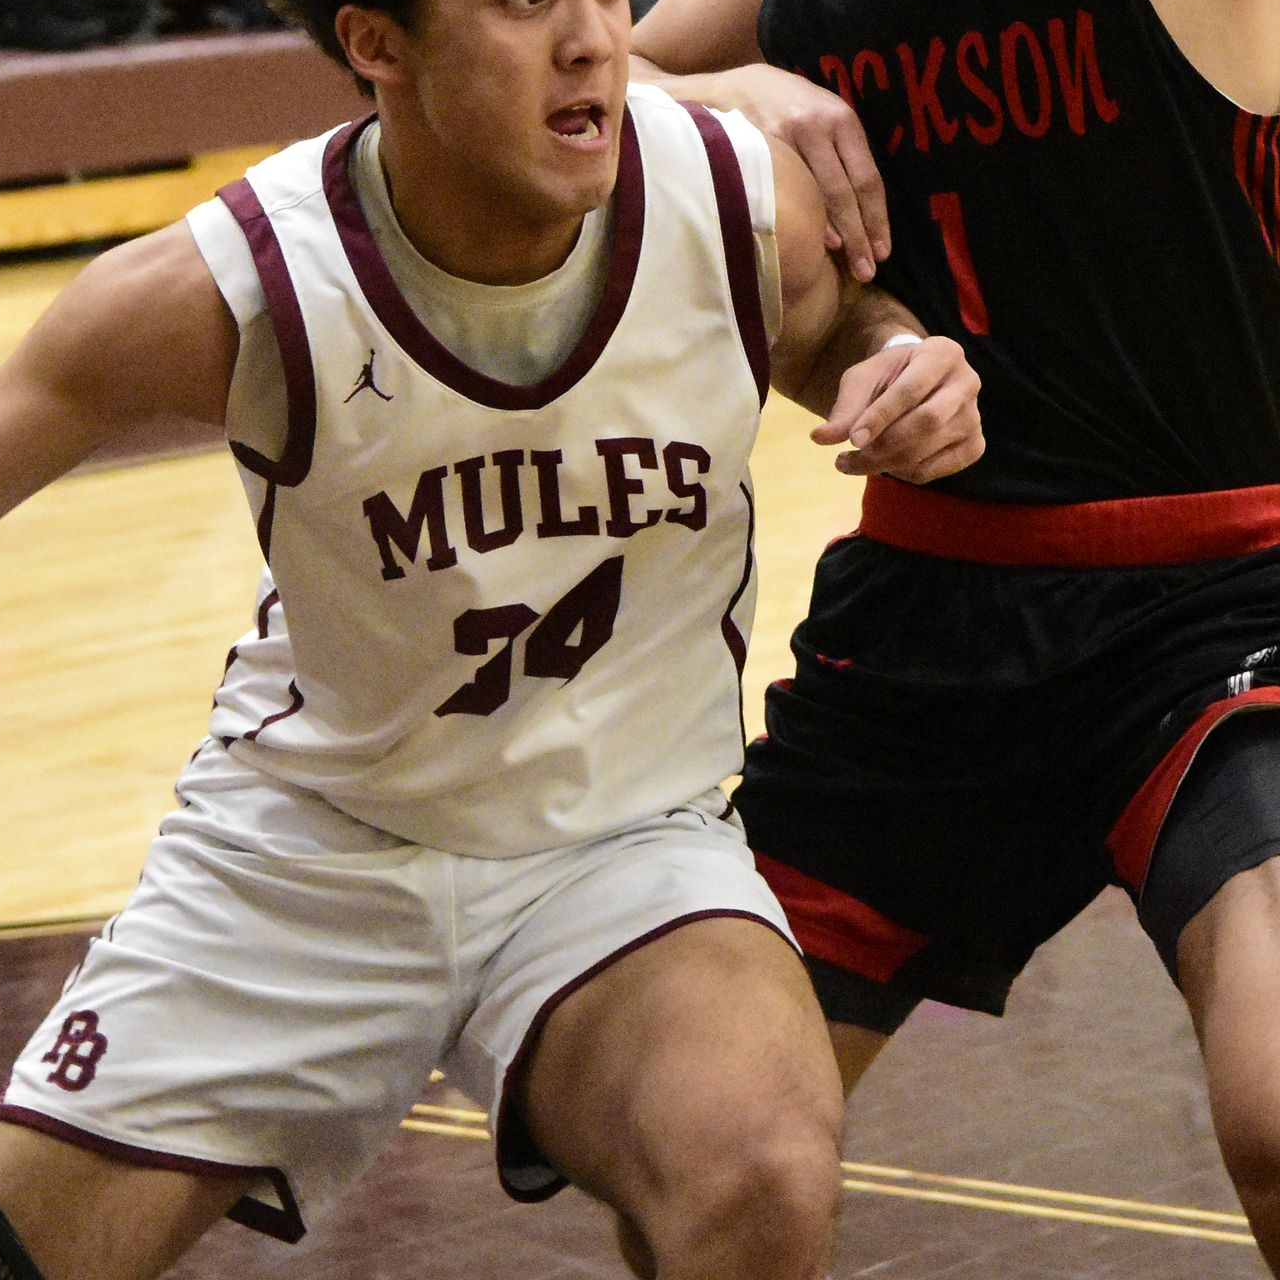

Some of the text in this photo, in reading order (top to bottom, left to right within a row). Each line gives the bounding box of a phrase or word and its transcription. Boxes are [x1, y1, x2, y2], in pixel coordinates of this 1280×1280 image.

[794, 9, 1120, 154] CKSON
[928, 192, 990, 336] 1
[362, 436, 712, 582] MULES
